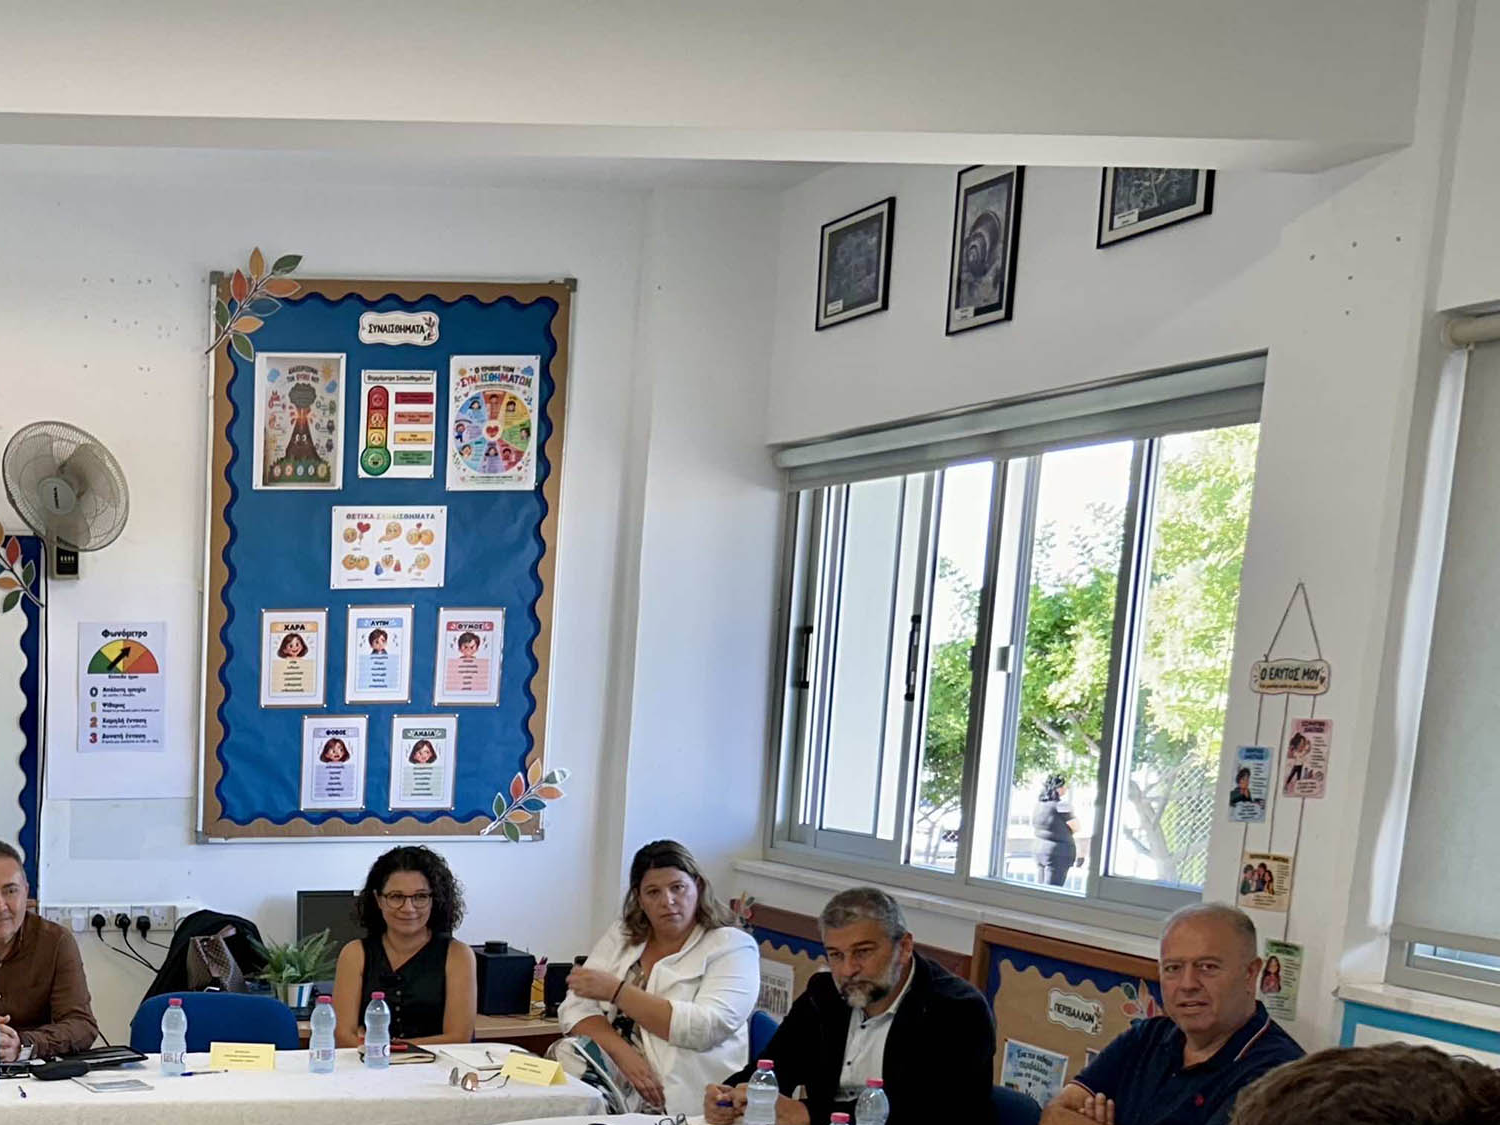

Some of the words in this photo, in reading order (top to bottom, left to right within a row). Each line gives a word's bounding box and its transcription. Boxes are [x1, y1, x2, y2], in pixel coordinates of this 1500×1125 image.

[368, 323, 425, 334] ΣΥΝΑΙΣΘΗΜΑΤΑ
[460, 373, 532, 388] ΣΥΝΑΙΣΘΗΜΑΤΩΝ
[101, 629, 148, 639] Φωνόμετρο
[1260, 668, 1268, 681] Ο
[1269, 667, 1300, 681] ΕΑΥΤΟΣ
[1301, 668, 1321, 681] ΜΟΥ
[90, 686, 98, 697] 0
[91, 702, 97, 713] 1
[90, 717, 98, 728] 2
[89, 733, 98, 744] 3
[1054, 1003, 1094, 1024] ΠΕΡΙΒΑΛΛΟΝ
